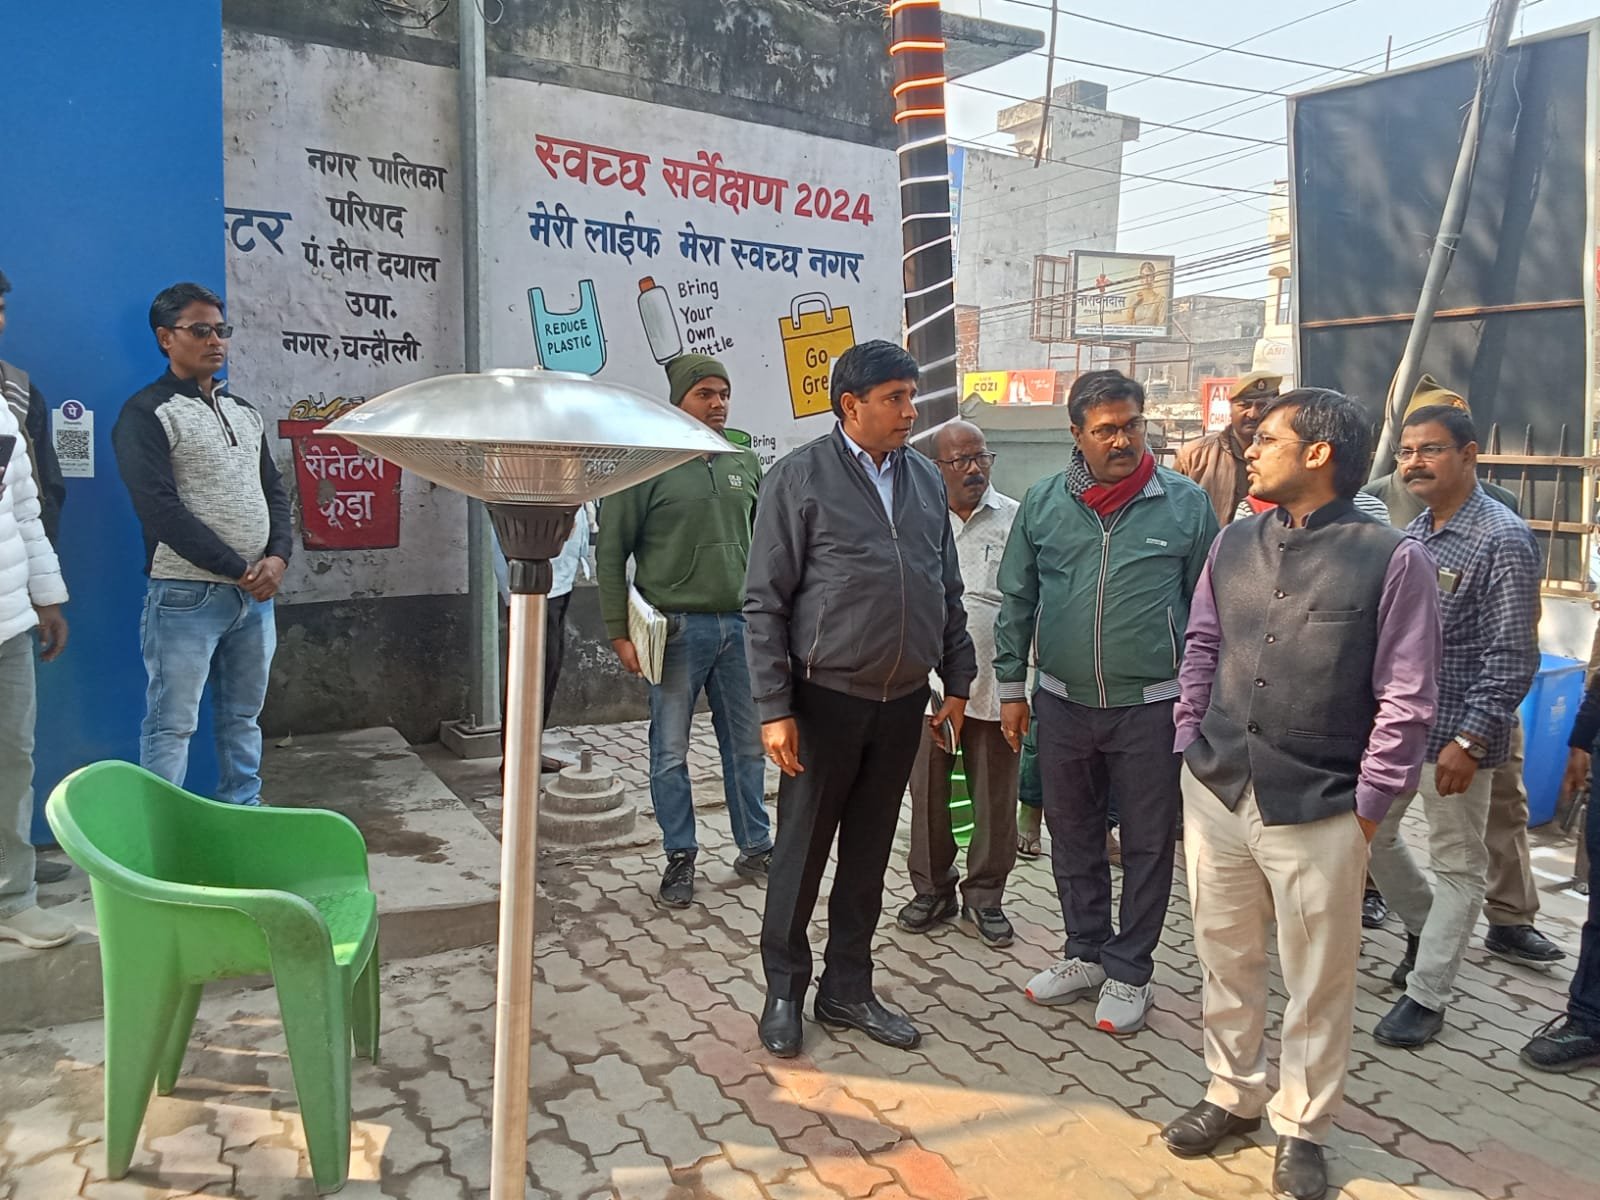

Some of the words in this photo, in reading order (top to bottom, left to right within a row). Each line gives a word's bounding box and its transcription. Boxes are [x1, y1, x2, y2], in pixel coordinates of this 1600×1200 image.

[305, 147, 361, 182] नगर
[368, 152, 448, 192] पालिका
[535, 133, 651, 196] स्वच्छ
[794, 183, 874, 226] 2024
[325, 191, 407, 238] परिषद
[224, 207, 292, 254] टर
[528, 200, 578, 249] मेरी
[584, 211, 662, 265] लाईफ
[678, 221, 725, 266] मेरा
[730, 238, 803, 278] स्वच्छ
[808, 248, 864, 284] नगर
[328, 238, 372, 276] दीन
[377, 252, 440, 282] दयाल
[677, 278, 719, 300] Bring
[345, 291, 397, 319] उपा.
[679, 305, 714, 325] Your
[545, 318, 588, 337] REDUCE
[687, 326, 715, 344] Own
[547, 335, 592, 355] PLASTIC
[806, 347, 828, 368] Go
[803, 375, 829, 395] Gre
[973, 382, 998, 392] COZI
[753, 434, 776, 450] Bring
[757, 453, 776, 465] our
